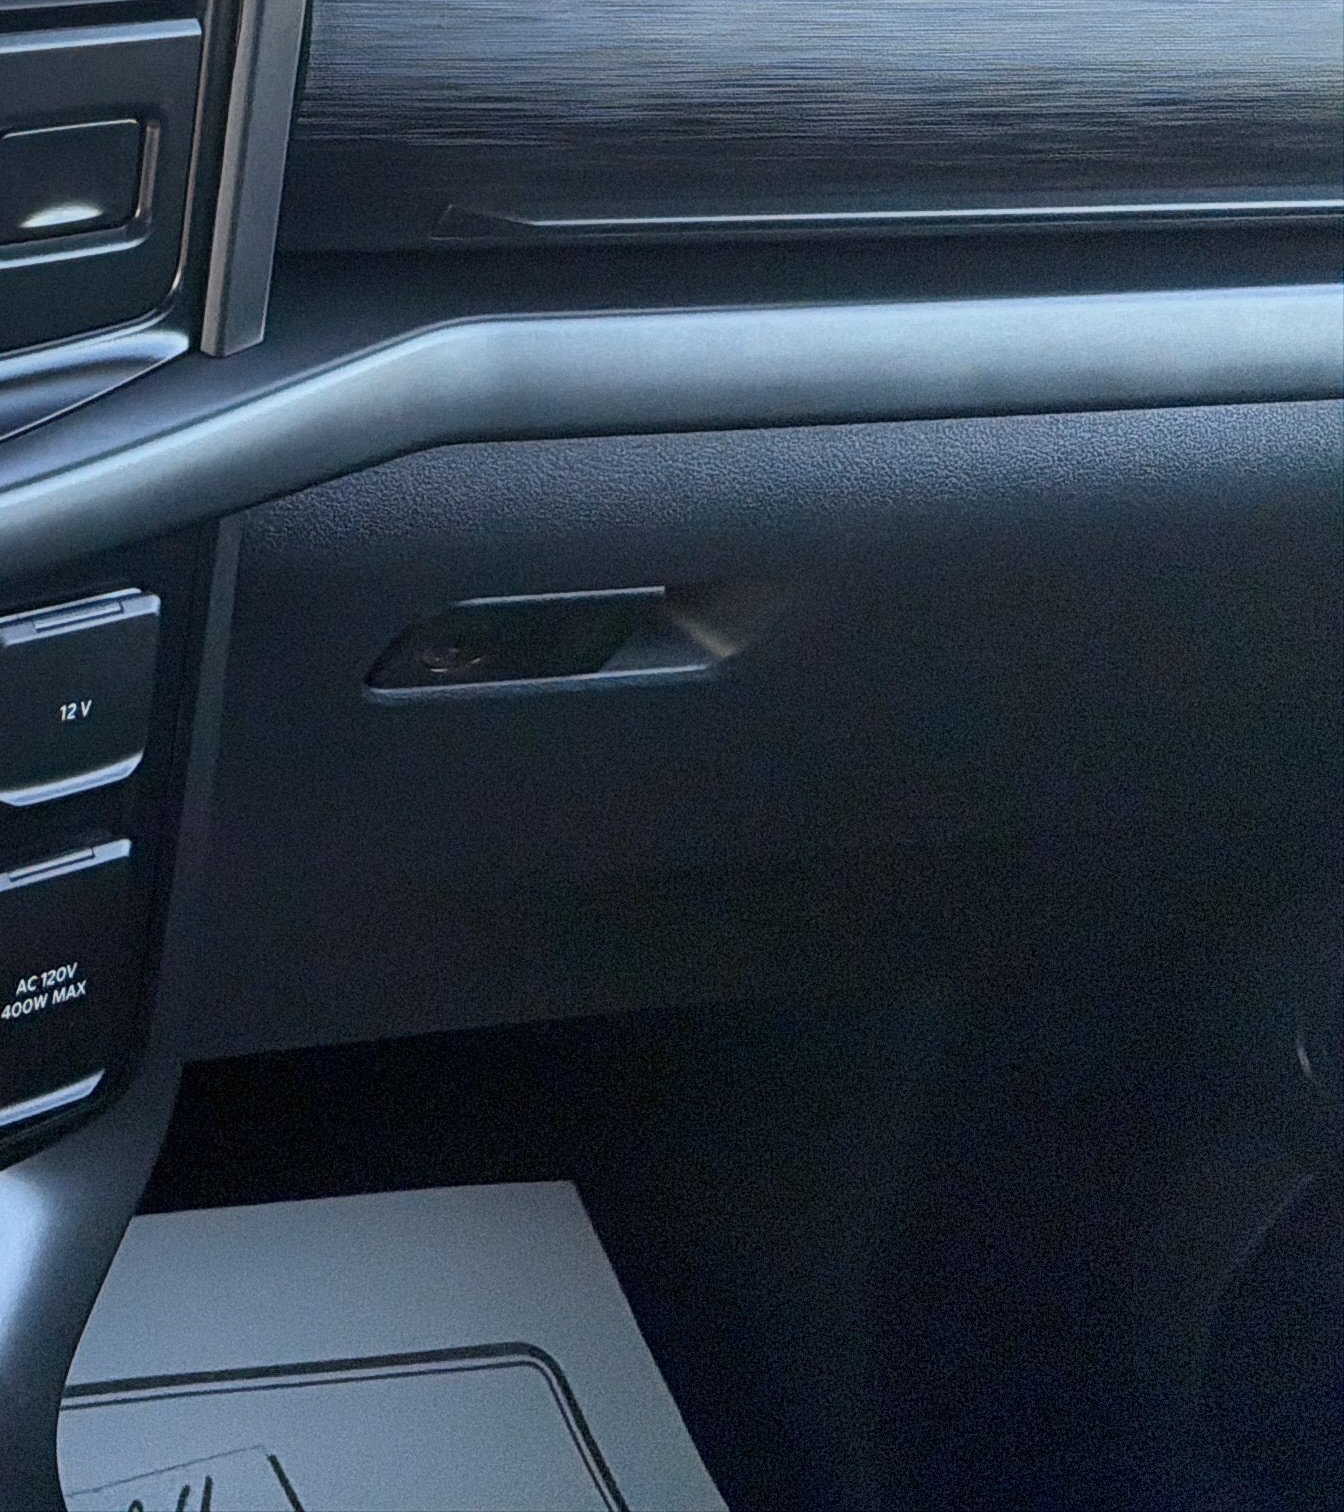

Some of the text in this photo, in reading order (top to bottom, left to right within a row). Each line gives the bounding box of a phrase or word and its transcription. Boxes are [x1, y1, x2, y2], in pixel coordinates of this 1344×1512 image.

[58, 698, 92, 722] 12 V
[14, 961, 78, 996] AC 120V
[0, 978, 87, 1022] 400W MAX
